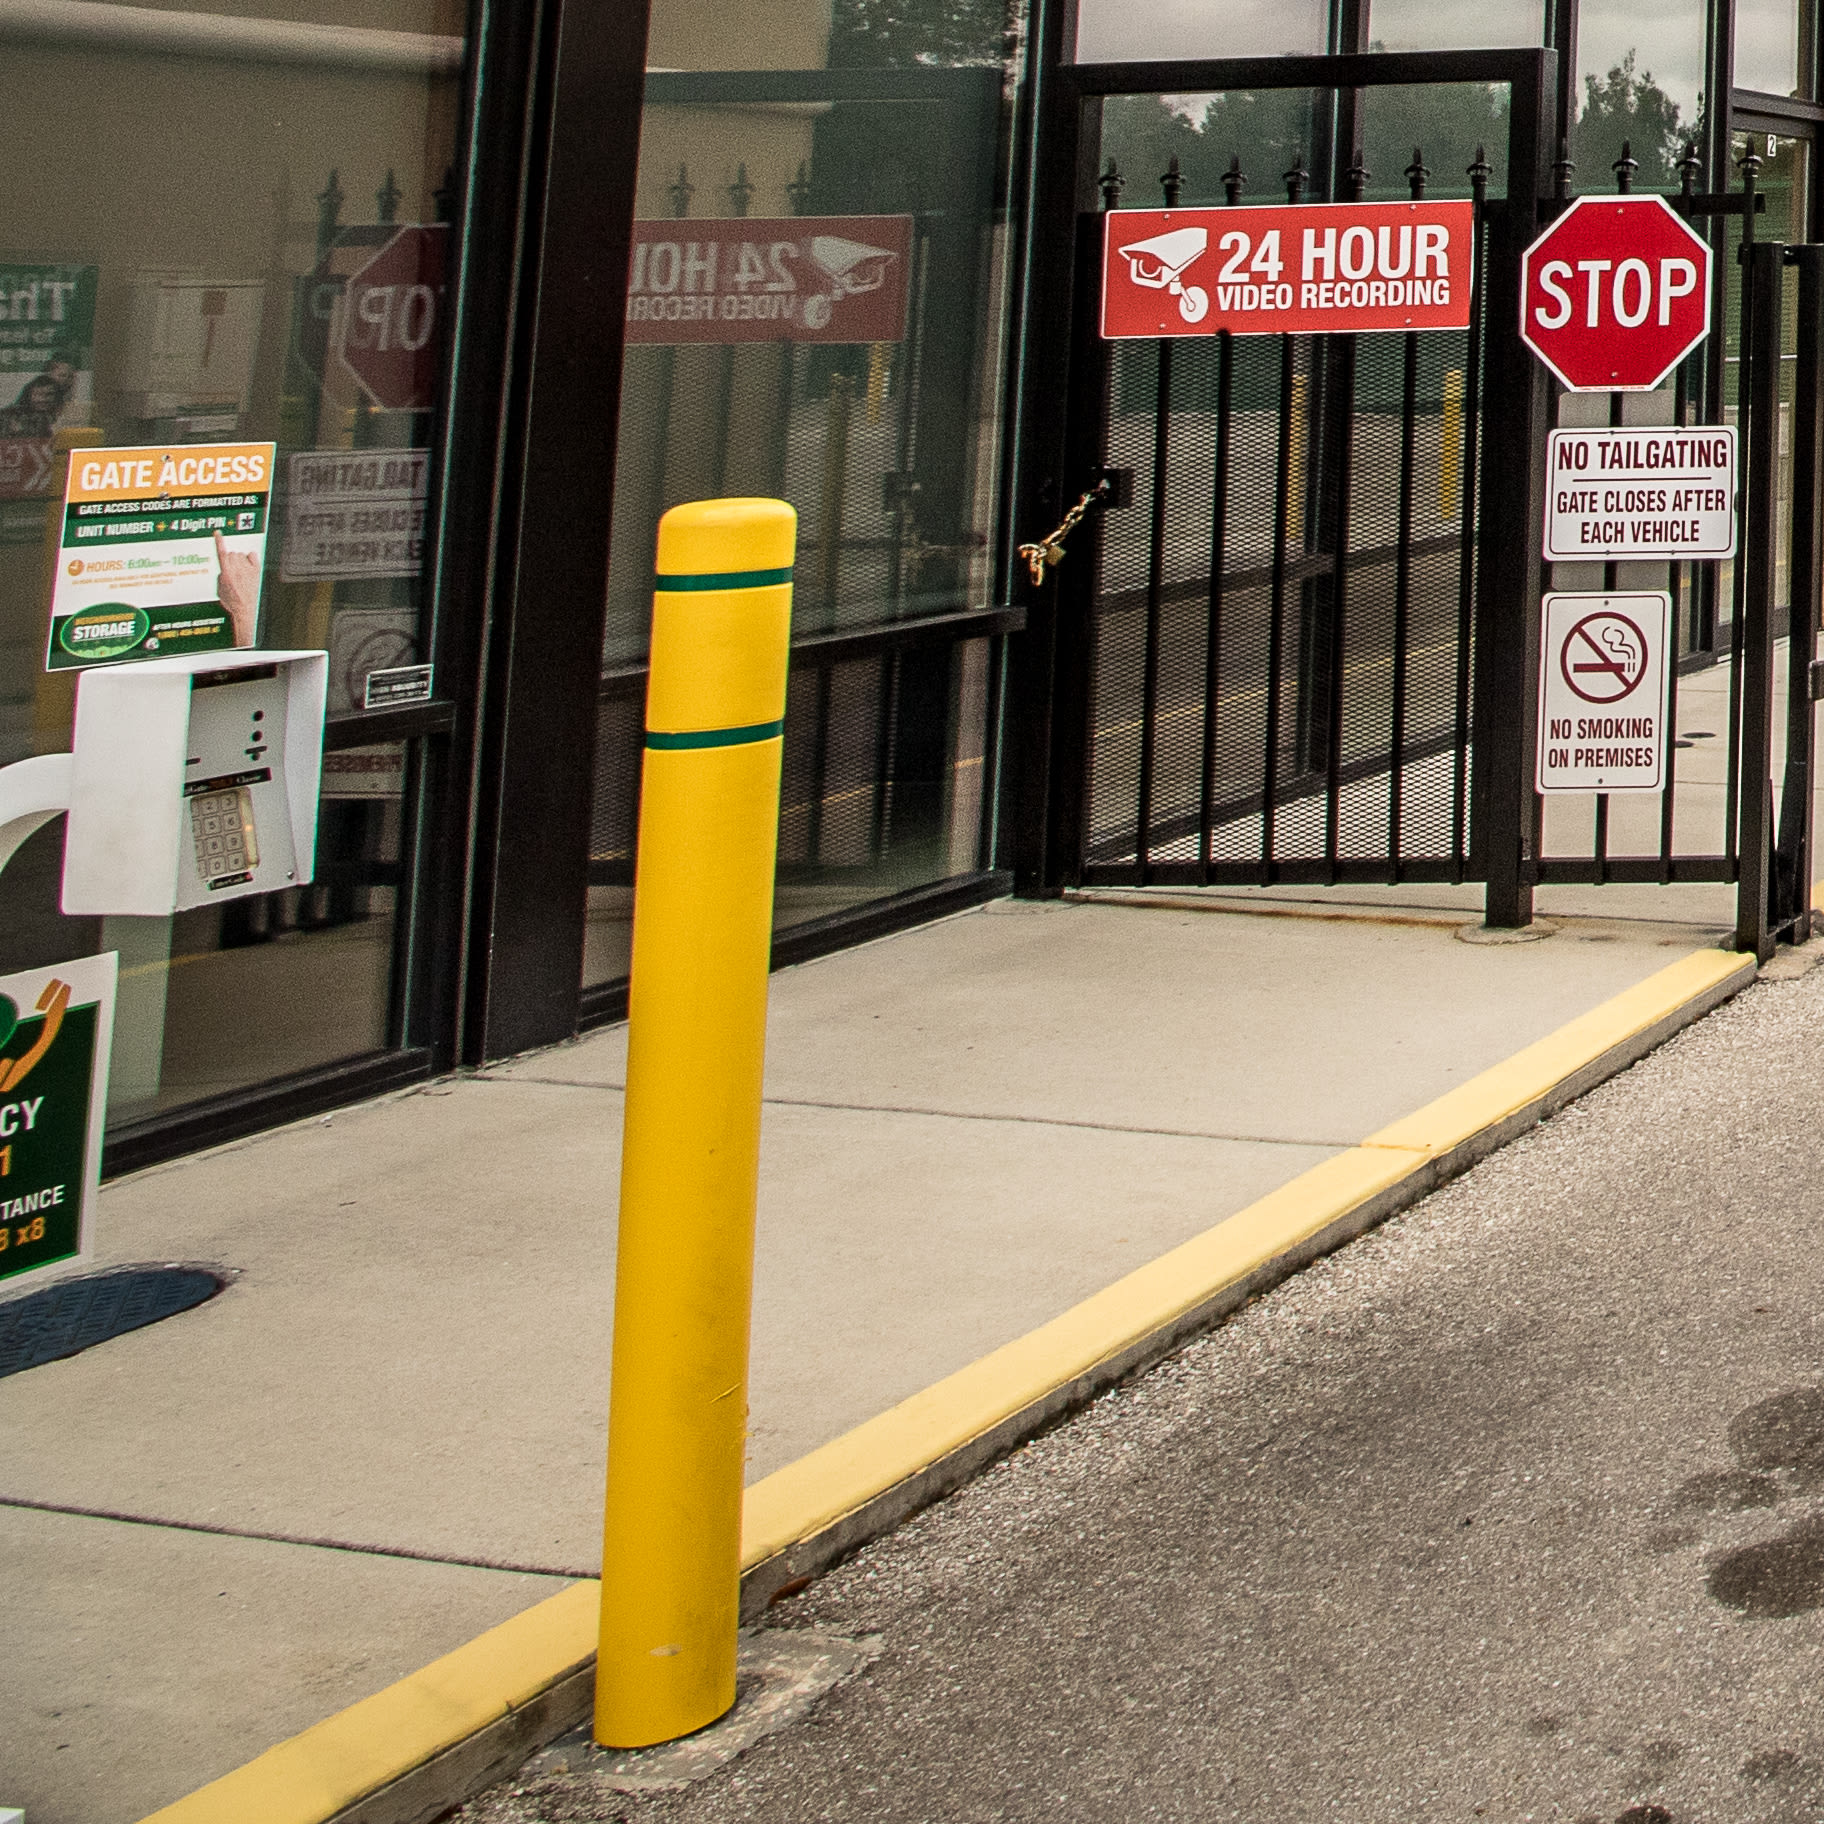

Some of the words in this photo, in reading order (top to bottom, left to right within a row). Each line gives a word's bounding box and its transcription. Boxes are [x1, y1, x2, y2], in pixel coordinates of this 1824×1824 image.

[1770, 136, 1774, 154] 2
[1218, 230, 1284, 283] 24
[1301, 225, 1450, 281] HOUR
[1216, 283, 1293, 311] VIDEO
[1301, 279, 1450, 309] RECORDING
[1535, 258, 1698, 329] STOP
[1558, 441, 1589, 470] NO
[1598, 440, 1727, 469] TAILGATING
[80, 460, 153, 491] GATE
[158, 455, 264, 487] ACCESS
[79, 504, 103, 516] GATE
[104, 502, 141, 514] ACCESS
[142, 500, 171, 512] CODES
[172, 498, 191, 510] ARE
[192, 496, 243, 508] FORMATTED
[1557, 491, 1598, 514] GATE
[1604, 490, 1666, 513] CLOSES
[1672, 489, 1726, 512] AFTER
[76, 525, 104, 538] UNIT
[105, 522, 154, 535] NUMBER
[170, 520, 179, 531] 4
[180, 518, 206, 532] Digit
[207, 516, 226, 528] PIN
[1580, 521, 1624, 544] EACH
[1630, 520, 1700, 543] VEHICLE
[73, 620, 136, 641] STORAGE
[1550, 719, 1572, 740] NO
[1577, 718, 1653, 739] SMOKING
[1549, 749, 1569, 768] ON
[1574, 748, 1653, 768] PREMISES
[16, 1216, 45, 1246] x8
